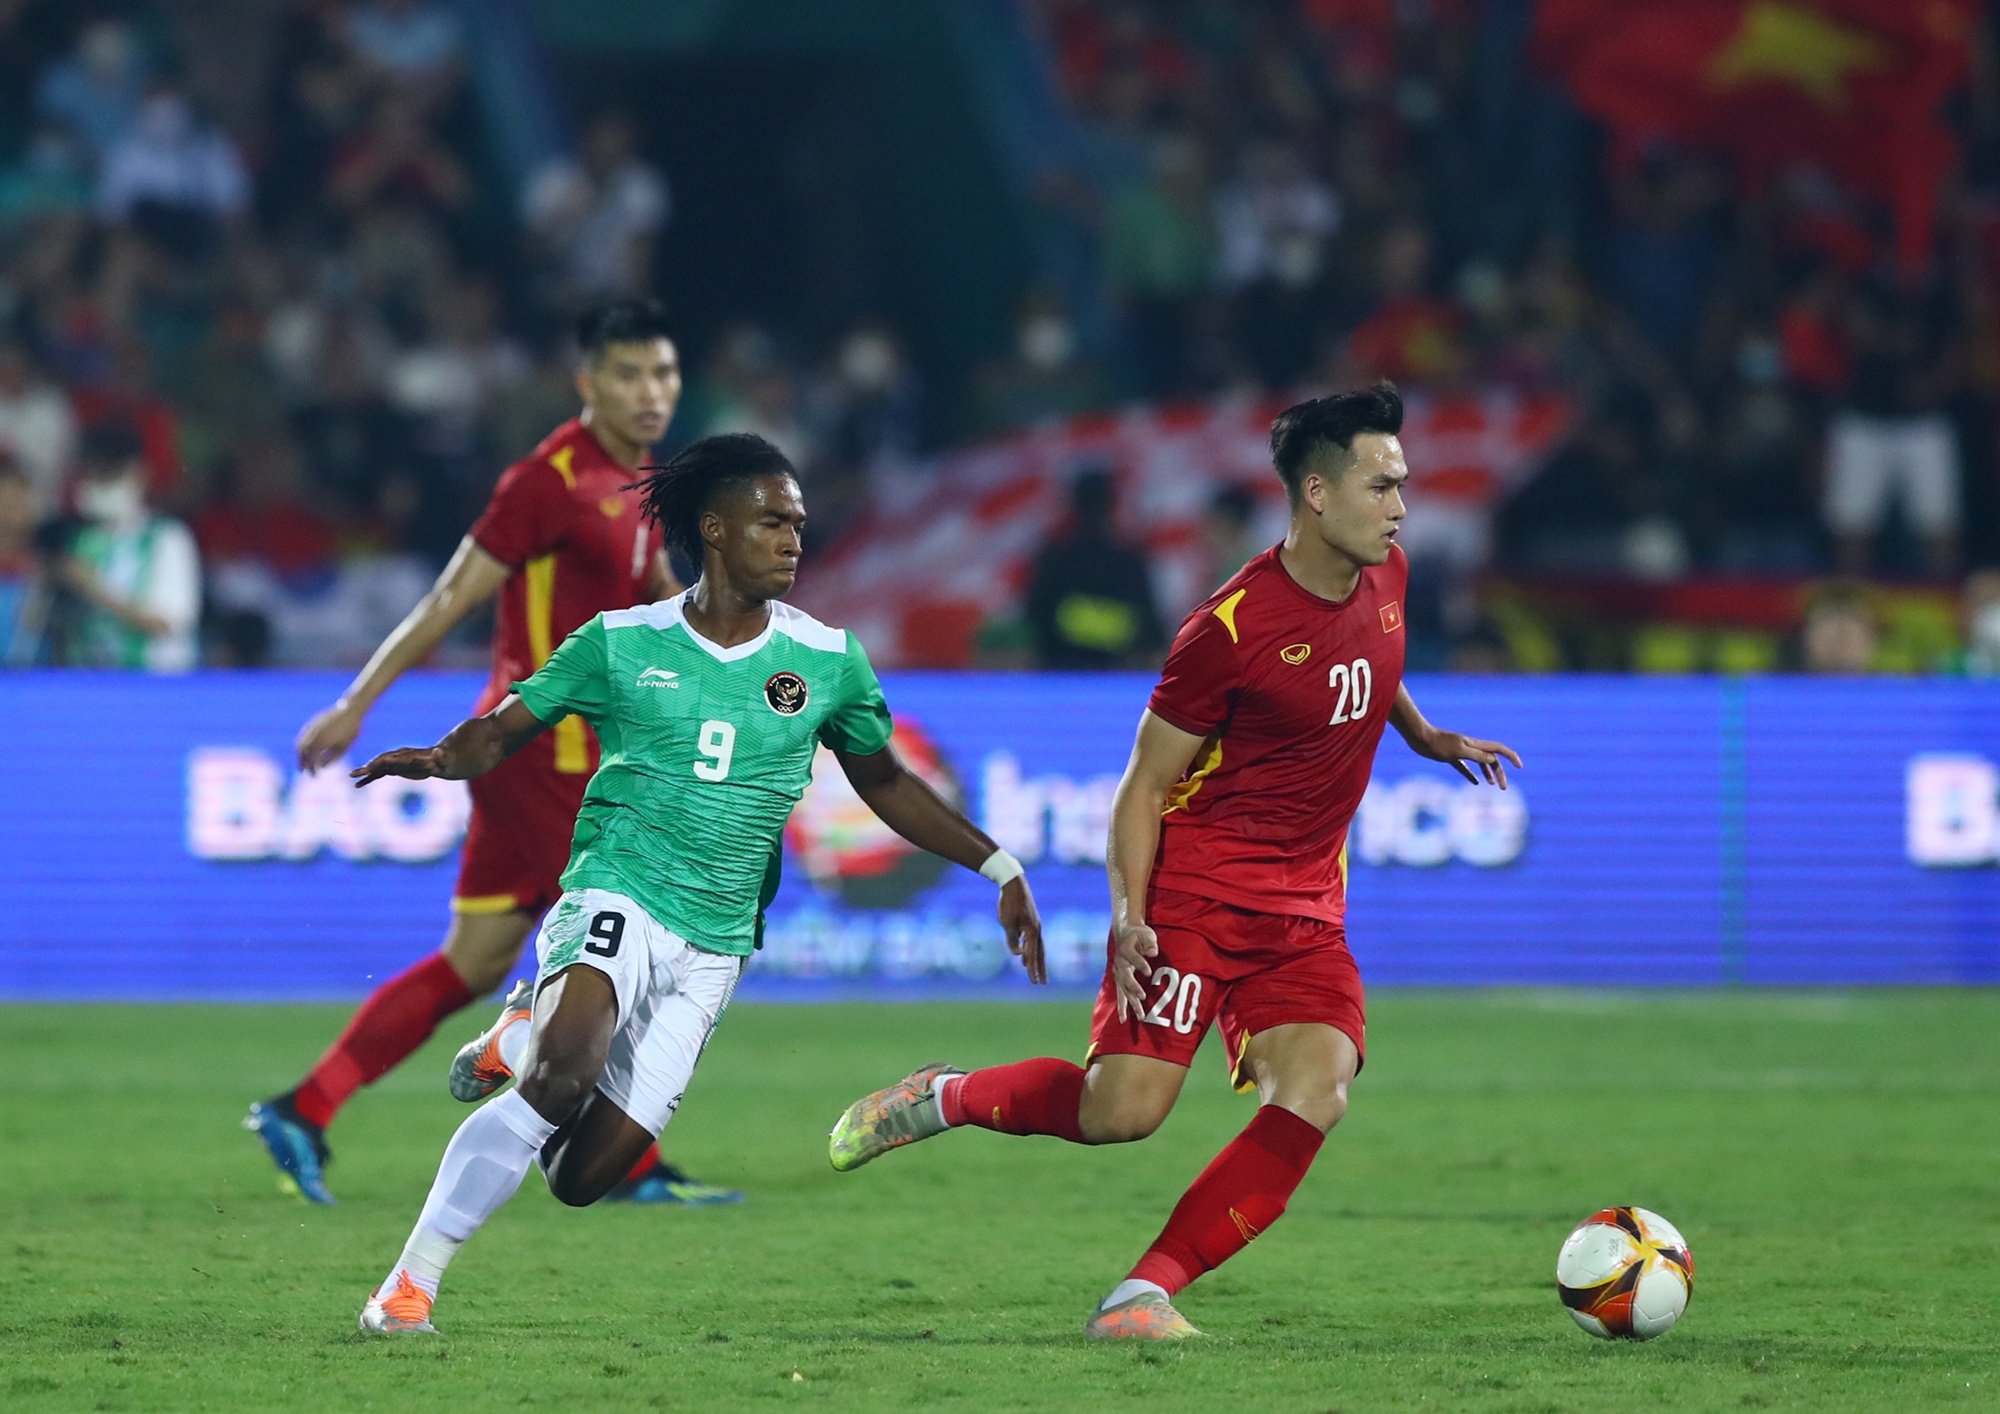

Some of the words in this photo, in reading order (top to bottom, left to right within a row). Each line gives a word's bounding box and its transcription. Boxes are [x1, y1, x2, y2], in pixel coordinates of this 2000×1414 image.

[636, 680, 680, 689] LI-NING
[1328, 658, 1372, 726] 20
[693, 719, 736, 783] 9
[584, 911, 626, 958] 9
[1143, 966, 1203, 1035] 20
